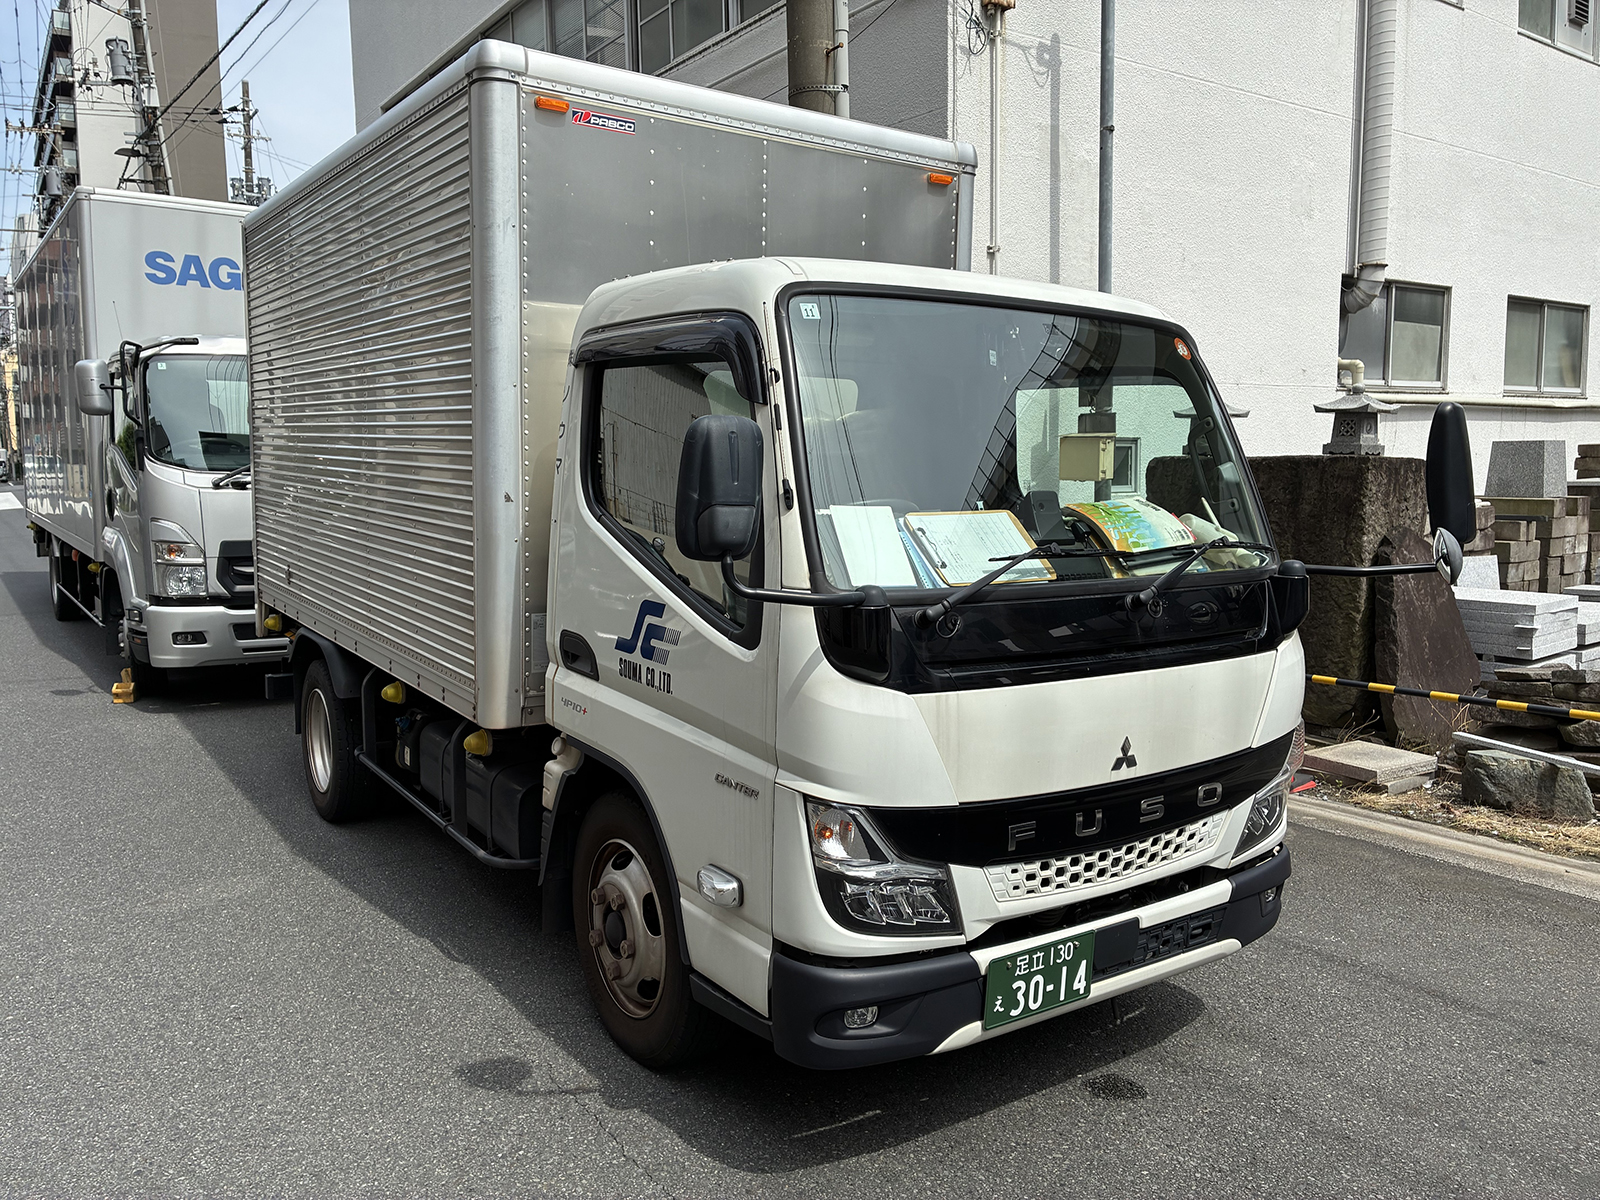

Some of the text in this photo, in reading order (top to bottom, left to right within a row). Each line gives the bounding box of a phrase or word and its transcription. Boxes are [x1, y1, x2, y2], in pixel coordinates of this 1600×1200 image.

[590, 116, 634, 131] PABCO
[144, 250, 243, 291] SAG
[618, 657, 643, 684] SOUMA
[715, 772, 759, 800] CANTER
[1007, 782, 1223, 851] FUSO
[1014, 942, 1074, 976] 足立 130
[993, 959, 1087, 1017] え 30-14
